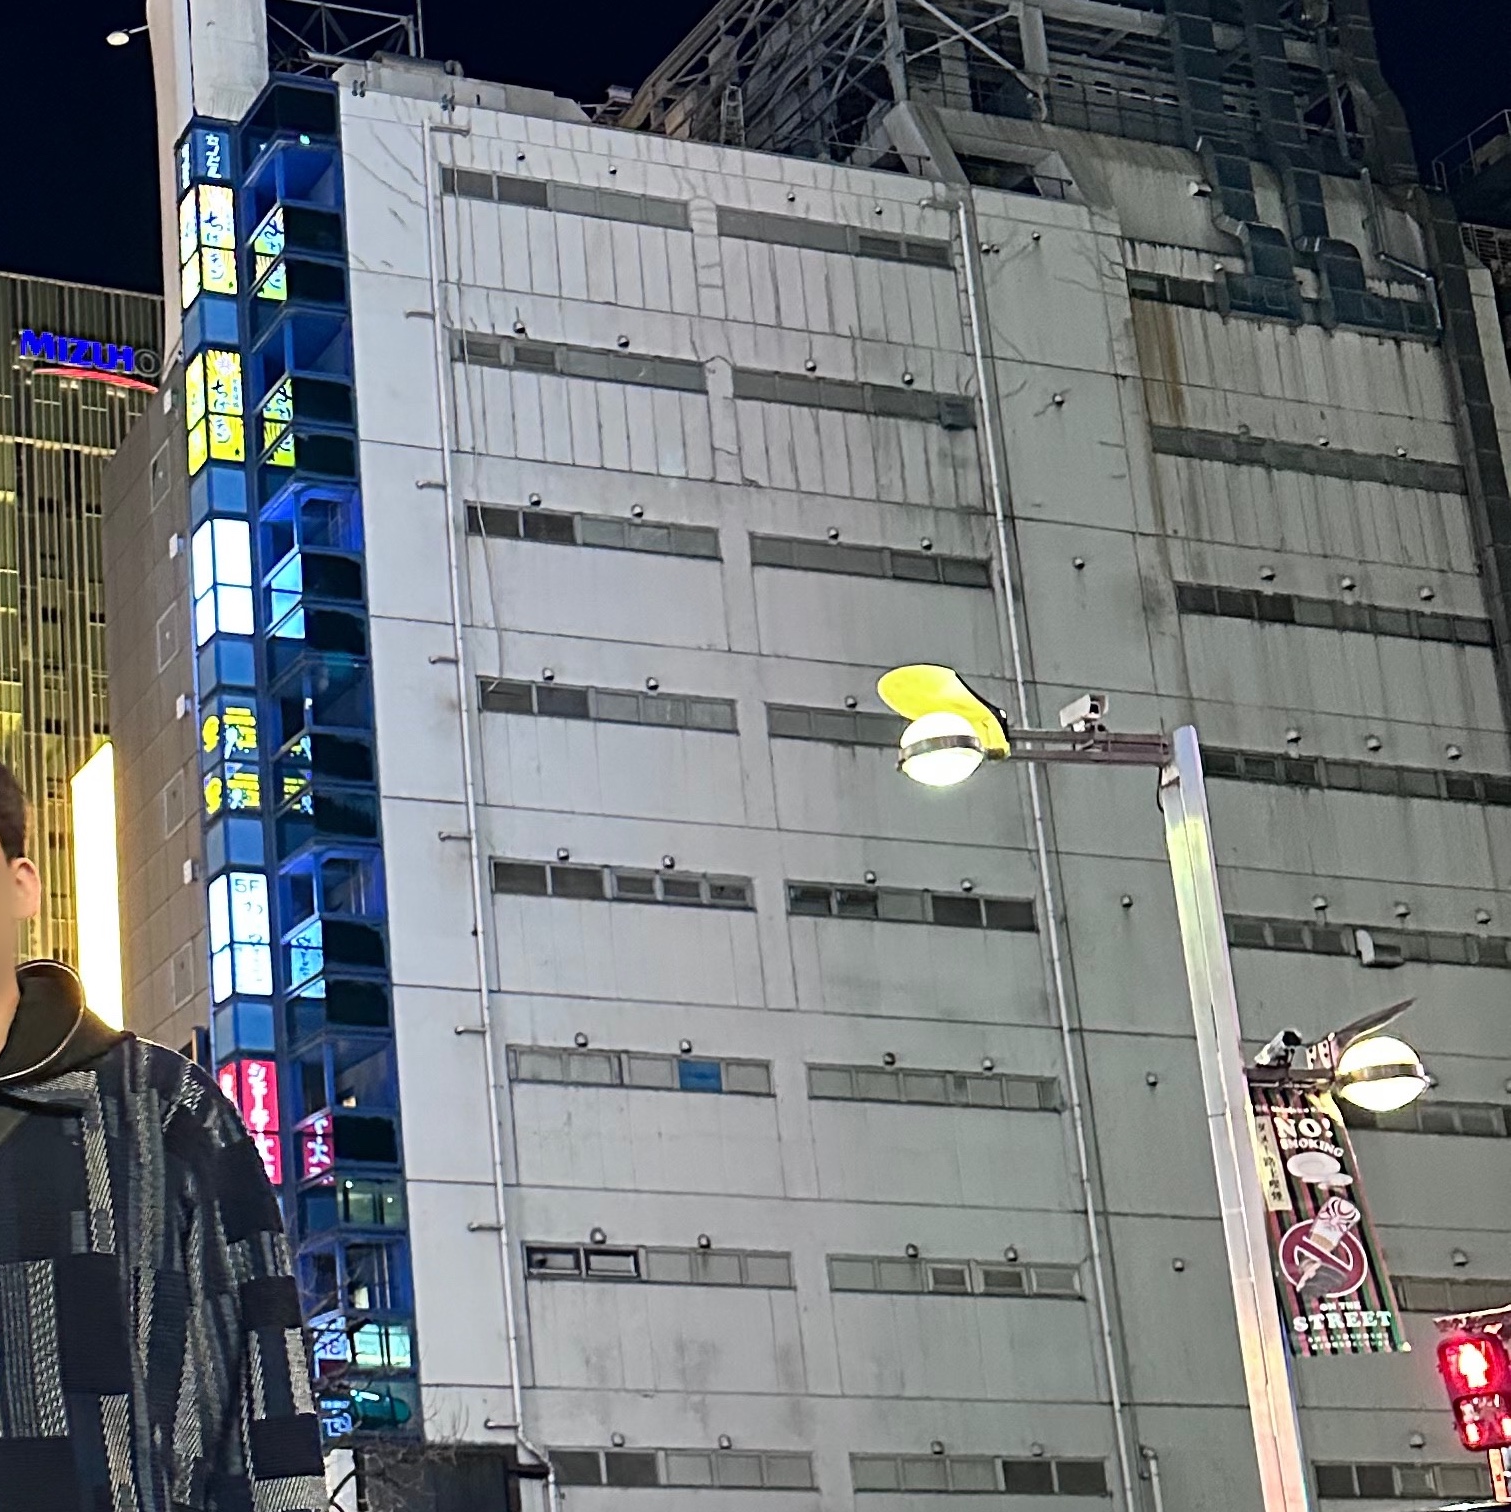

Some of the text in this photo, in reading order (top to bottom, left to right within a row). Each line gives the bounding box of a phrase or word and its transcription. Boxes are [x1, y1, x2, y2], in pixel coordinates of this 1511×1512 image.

[19, 328, 163, 379] MIZUHO
[234, 878, 260, 893] 5F
[1273, 1116, 1334, 1139] NO!
[1279, 1137, 1345, 1158] SMOKING
[1292, 1310, 1393, 1333] STREET
